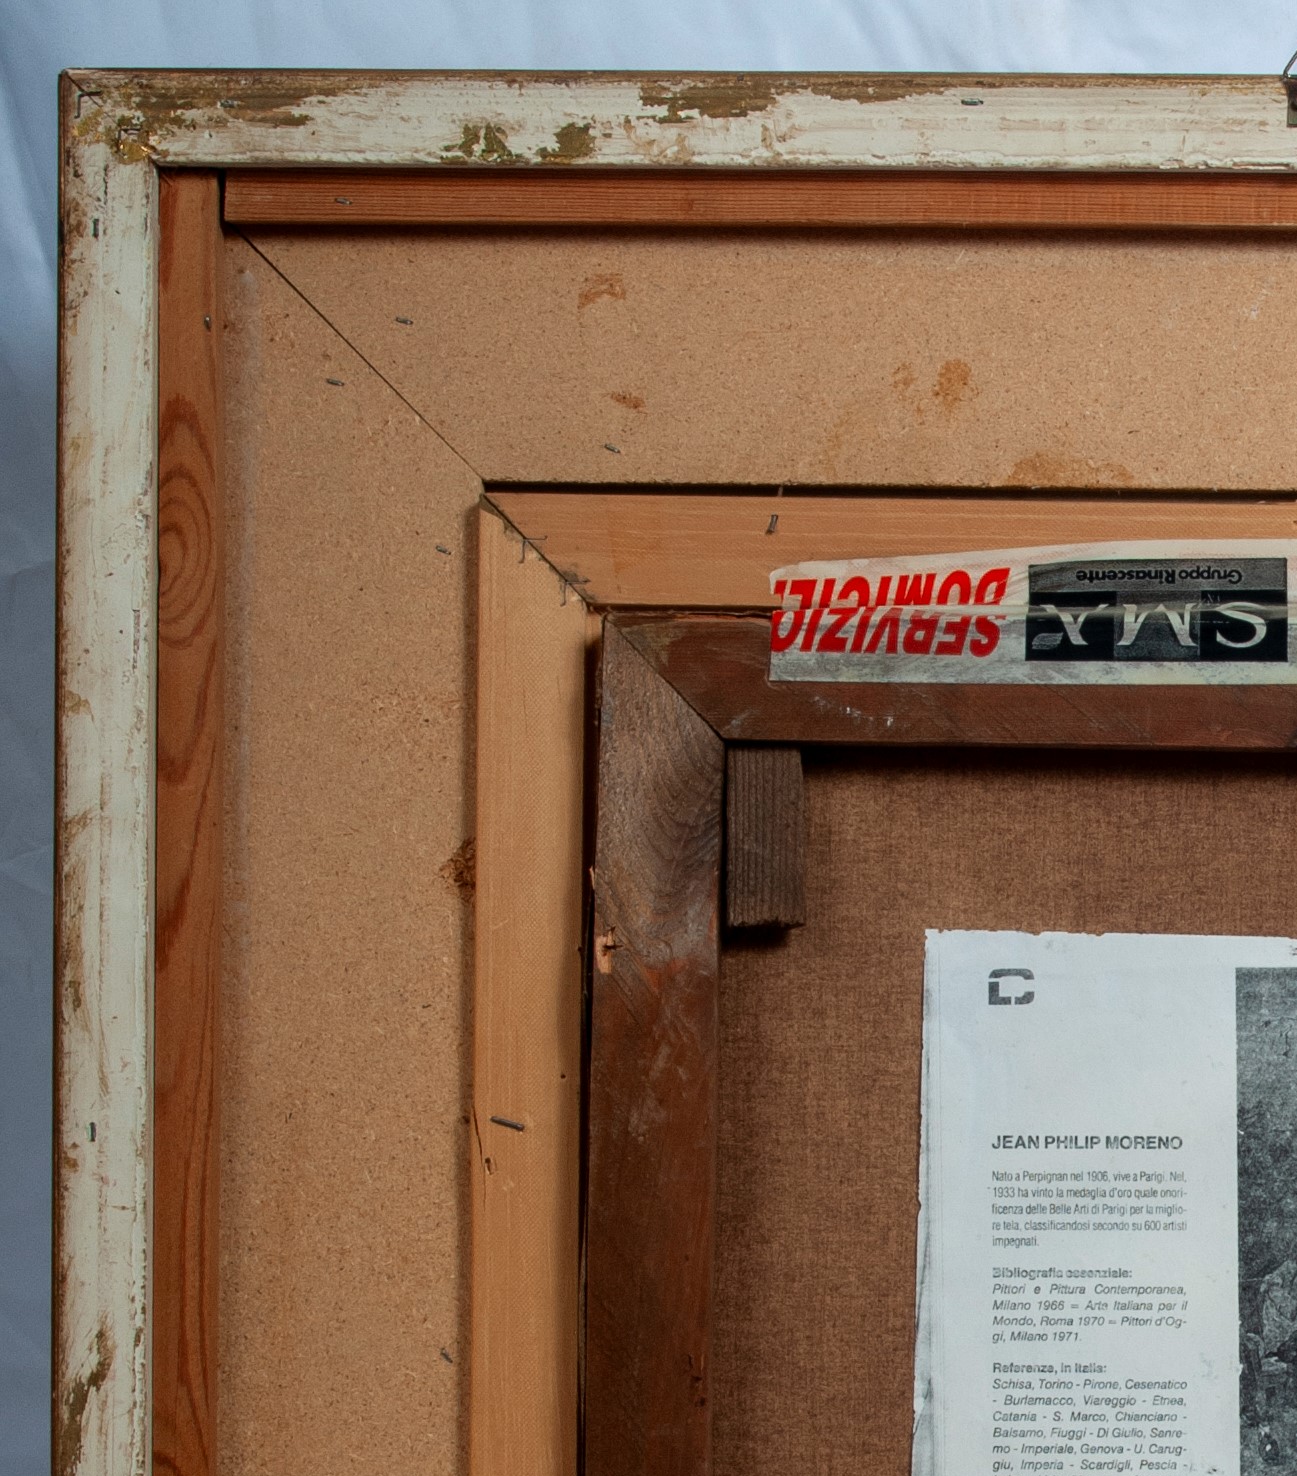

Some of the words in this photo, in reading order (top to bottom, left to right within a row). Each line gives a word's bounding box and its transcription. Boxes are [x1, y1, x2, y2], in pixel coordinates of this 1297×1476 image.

[1075, 568, 1177, 586] Rinascente
[1178, 568, 1243, 585] Gruppo
[771, 605, 1007, 658] SERVIZIO
[991, 1134, 1040, 1150] JEAN
[1044, 1135, 1101, 1150] PHILIP
[1105, 1135, 1183, 1150] MORENO
[991, 1170, 1013, 1182] Nato
[1014, 1172, 1021, 1182] a
[1022, 1170, 1069, 1184] Perpignan
[1070, 1170, 1084, 1182] nel
[1113, 1170, 1131, 1182] vive
[1132, 1172, 1138, 1183] a
[993, 1186, 1016, 1199] 1933
[1017, 1186, 1029, 1199] ha
[1031, 1187, 1054, 1199] vinto
[1056, 1186, 1064, 1199] la
[1066, 1186, 1107, 1201] medaglia
[1109, 1186, 1132, 1199] d'oro
[1134, 1187, 1158, 1201] quale
[991, 1283, 1027, 1295] Pittori
[1033, 1285, 1042, 1295] e
[1048, 1283, 1087, 1295] Pittura
[1093, 1283, 1187, 1297] Contemporanea,
[992, 1299, 1031, 1311] Milano
[1113, 1300, 1153, 1311] Italiana
[1157, 1302, 1176, 1315] per
[1181, 1300, 1188, 1311] il
[992, 1315, 1036, 1328] Mondo,
[1040, 1315, 1074, 1327] Roma
[1078, 1315, 1105, 1327] 1970
[1120, 1315, 1153, 1327] Pittori
[1010, 1330, 1048, 1342] Milano
[1061, 1362, 1072, 1374] in
[1074, 1362, 1107, 1374] Italia:
[1039, 1378, 1074, 1390] Torino
[1124, 1378, 1188, 1390] Cesenatico
[1003, 1394, 1076, 1407] Burlamacco,
[1083, 1394, 1137, 1409] Viareggio
[992, 1410, 1037, 1422] Catania
[1069, 1411, 1109, 1423] Marco,
[1115, 1410, 1178, 1423] Chianciano
[992, 1426, 1046, 1440] Balsamo,
[1050, 1427, 1087, 1441] Fiuggi
[1096, 1427, 1109, 1439] Di
[1021, 1443, 1077, 1457] Imperiale,
[1080, 1443, 1124, 1455] Genova
[1148, 1443, 1188, 1457] Carug-
[992, 1459, 1014, 1473] giu,
[1020, 1459, 1064, 1473] Imperia
[1080, 1458, 1133, 1473] Scardigli,
[1139, 1459, 1177, 1471] Pescia
